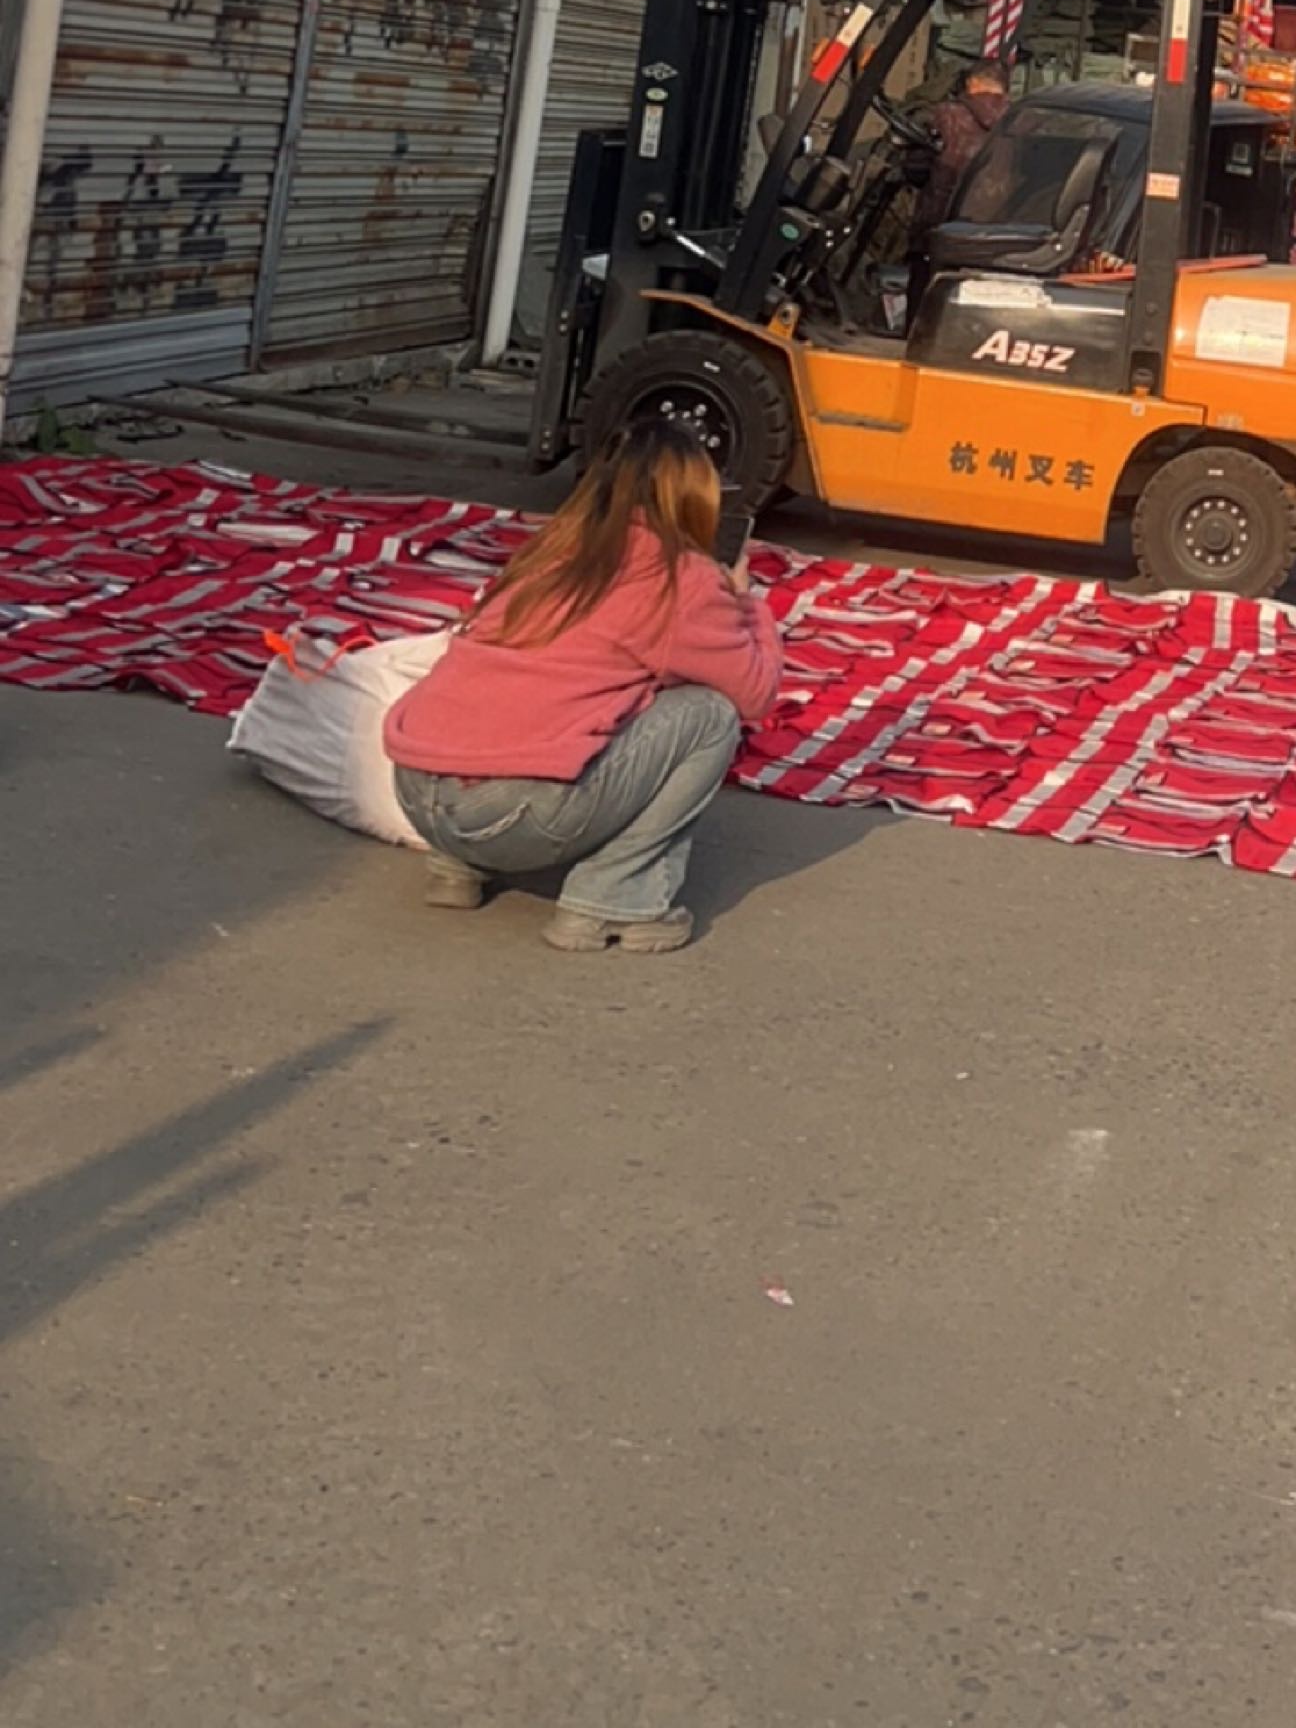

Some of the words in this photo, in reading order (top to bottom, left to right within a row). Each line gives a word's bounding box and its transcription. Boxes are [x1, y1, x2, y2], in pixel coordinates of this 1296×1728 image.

[971, 329, 1076, 373] A35Z
[949, 440, 1096, 491] 杭州叉车
